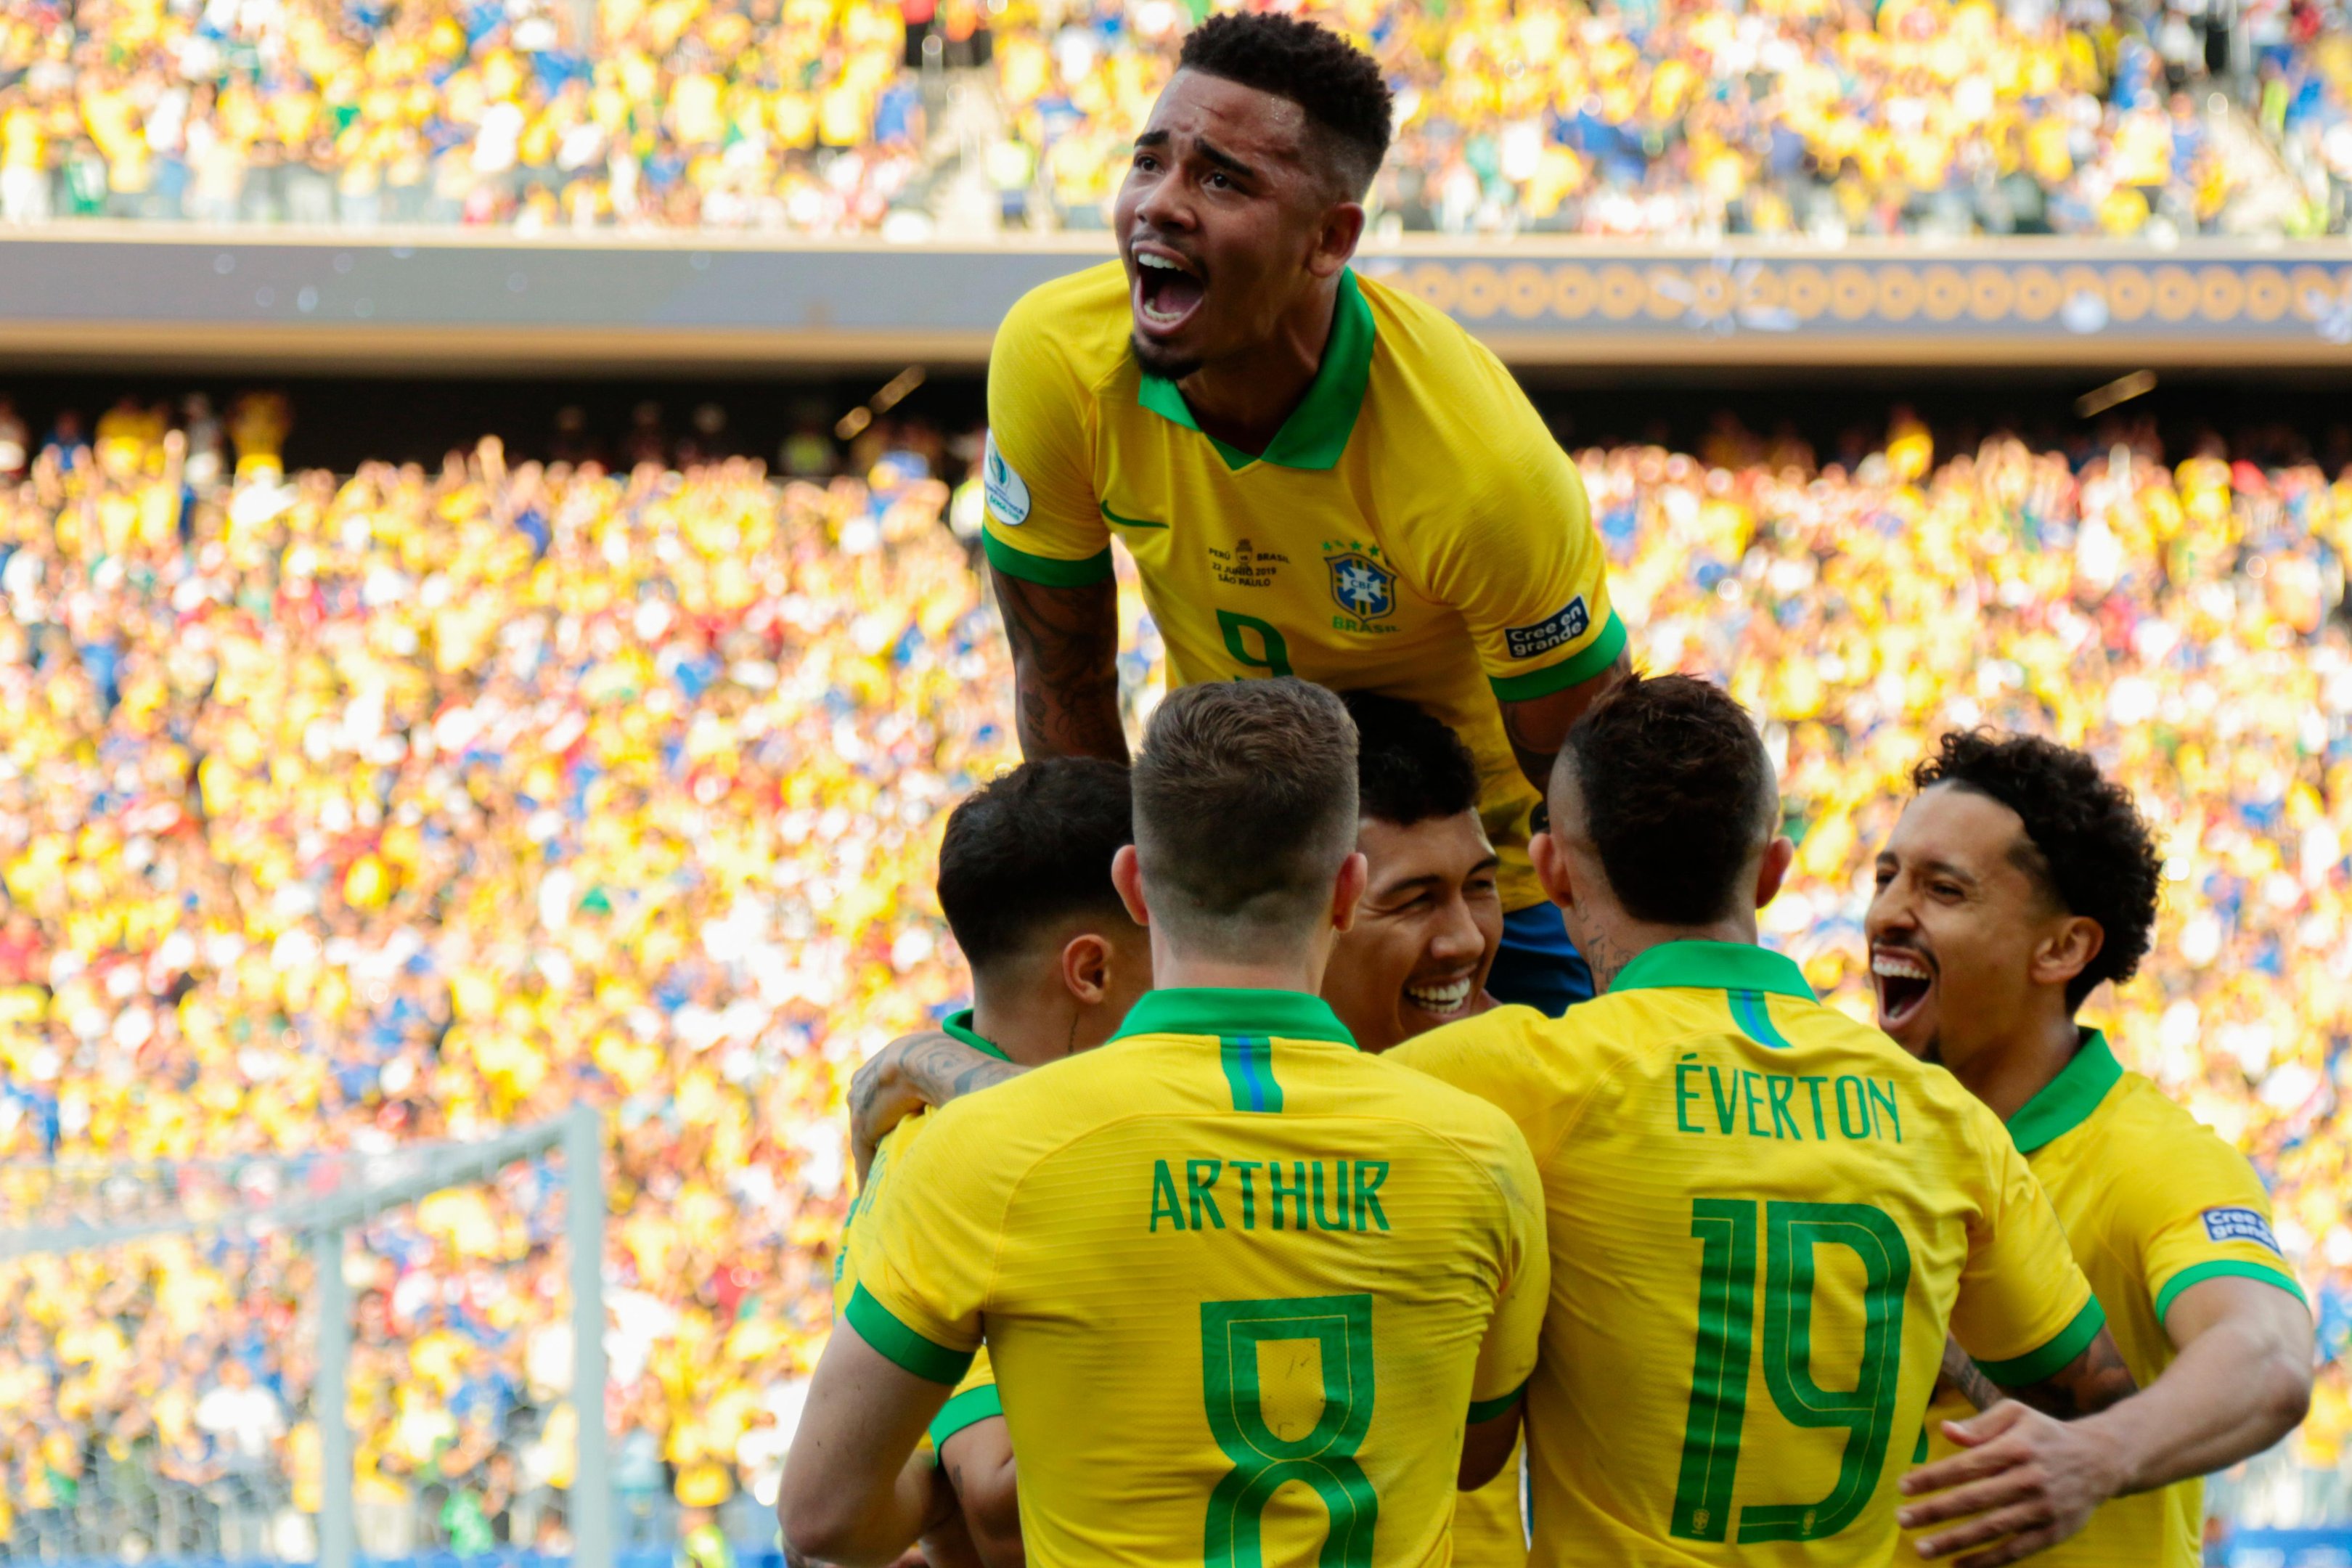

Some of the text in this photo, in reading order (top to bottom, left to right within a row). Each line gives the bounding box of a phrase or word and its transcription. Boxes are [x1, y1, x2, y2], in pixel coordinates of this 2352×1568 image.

[1256, 566, 1276, 576] 2019
[1257, 552, 1290, 564] BRASIL
[1238, 578, 1271, 587] PAULO
[1350, 579, 1373, 590] CBF
[1333, 615, 1401, 634] BRASIL
[1510, 605, 1583, 642] Cree en
[1512, 621, 1583, 656] grande
[1675, 1053, 1903, 1144] ÉVERTON
[1149, 1159, 1391, 1233] ARTHUR
[2207, 1210, 2257, 1226] Cree
[1670, 1197, 1911, 1545] 19
[1200, 1293, 1379, 1568] 8
